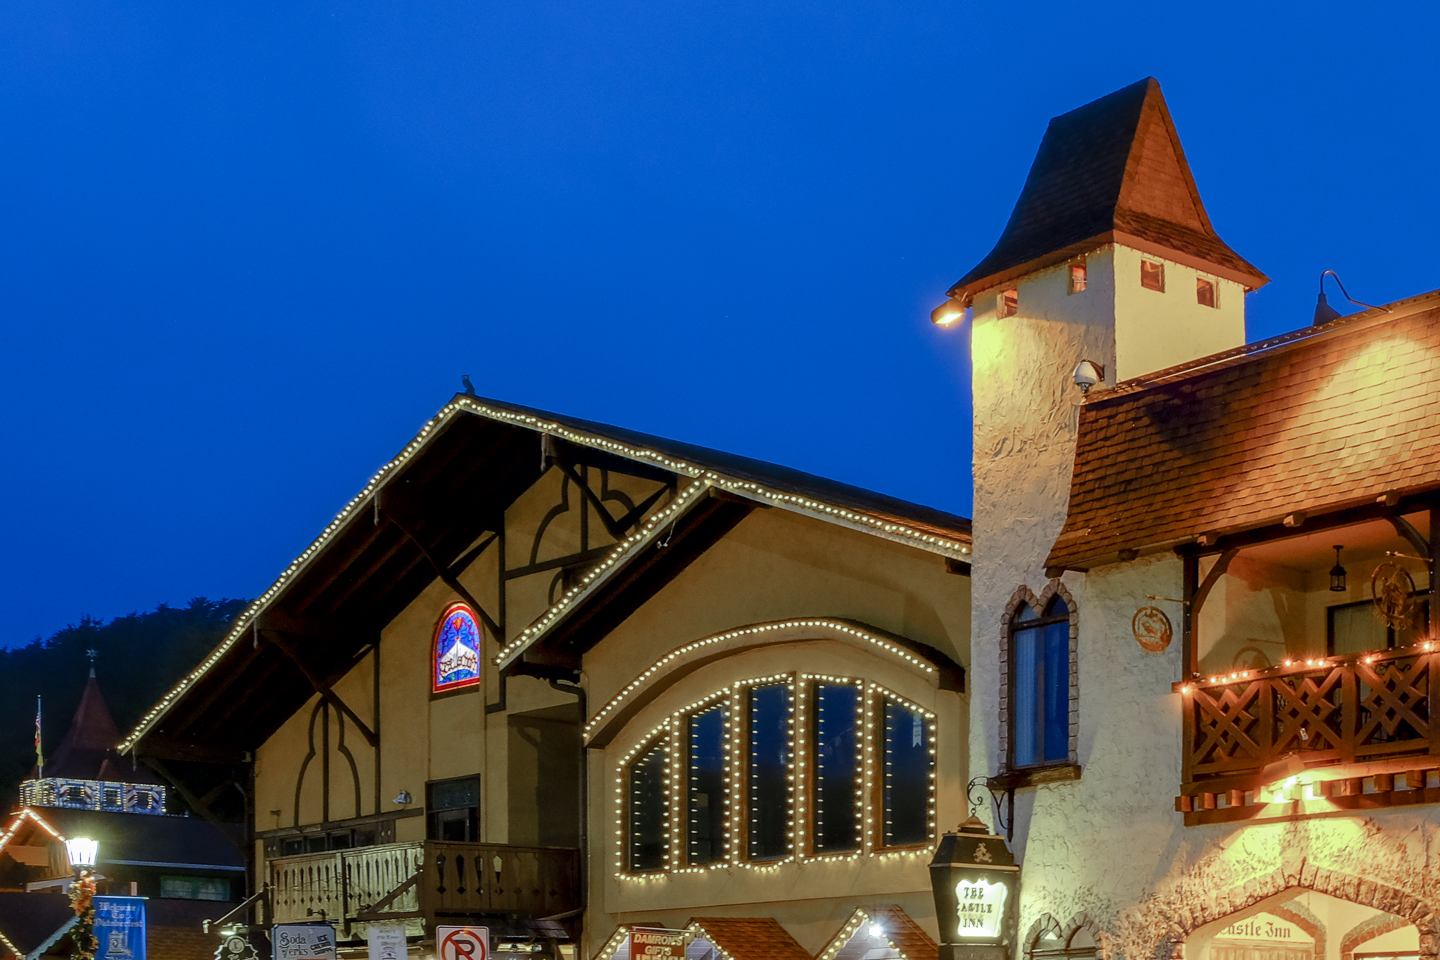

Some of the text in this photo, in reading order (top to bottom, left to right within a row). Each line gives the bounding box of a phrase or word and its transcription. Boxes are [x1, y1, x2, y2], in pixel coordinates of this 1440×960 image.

[963, 918, 984, 928] INN
[1265, 921, 1291, 938] Inn
[279, 931, 307, 947] Soda
[644, 945, 672, 956] GIFTS
